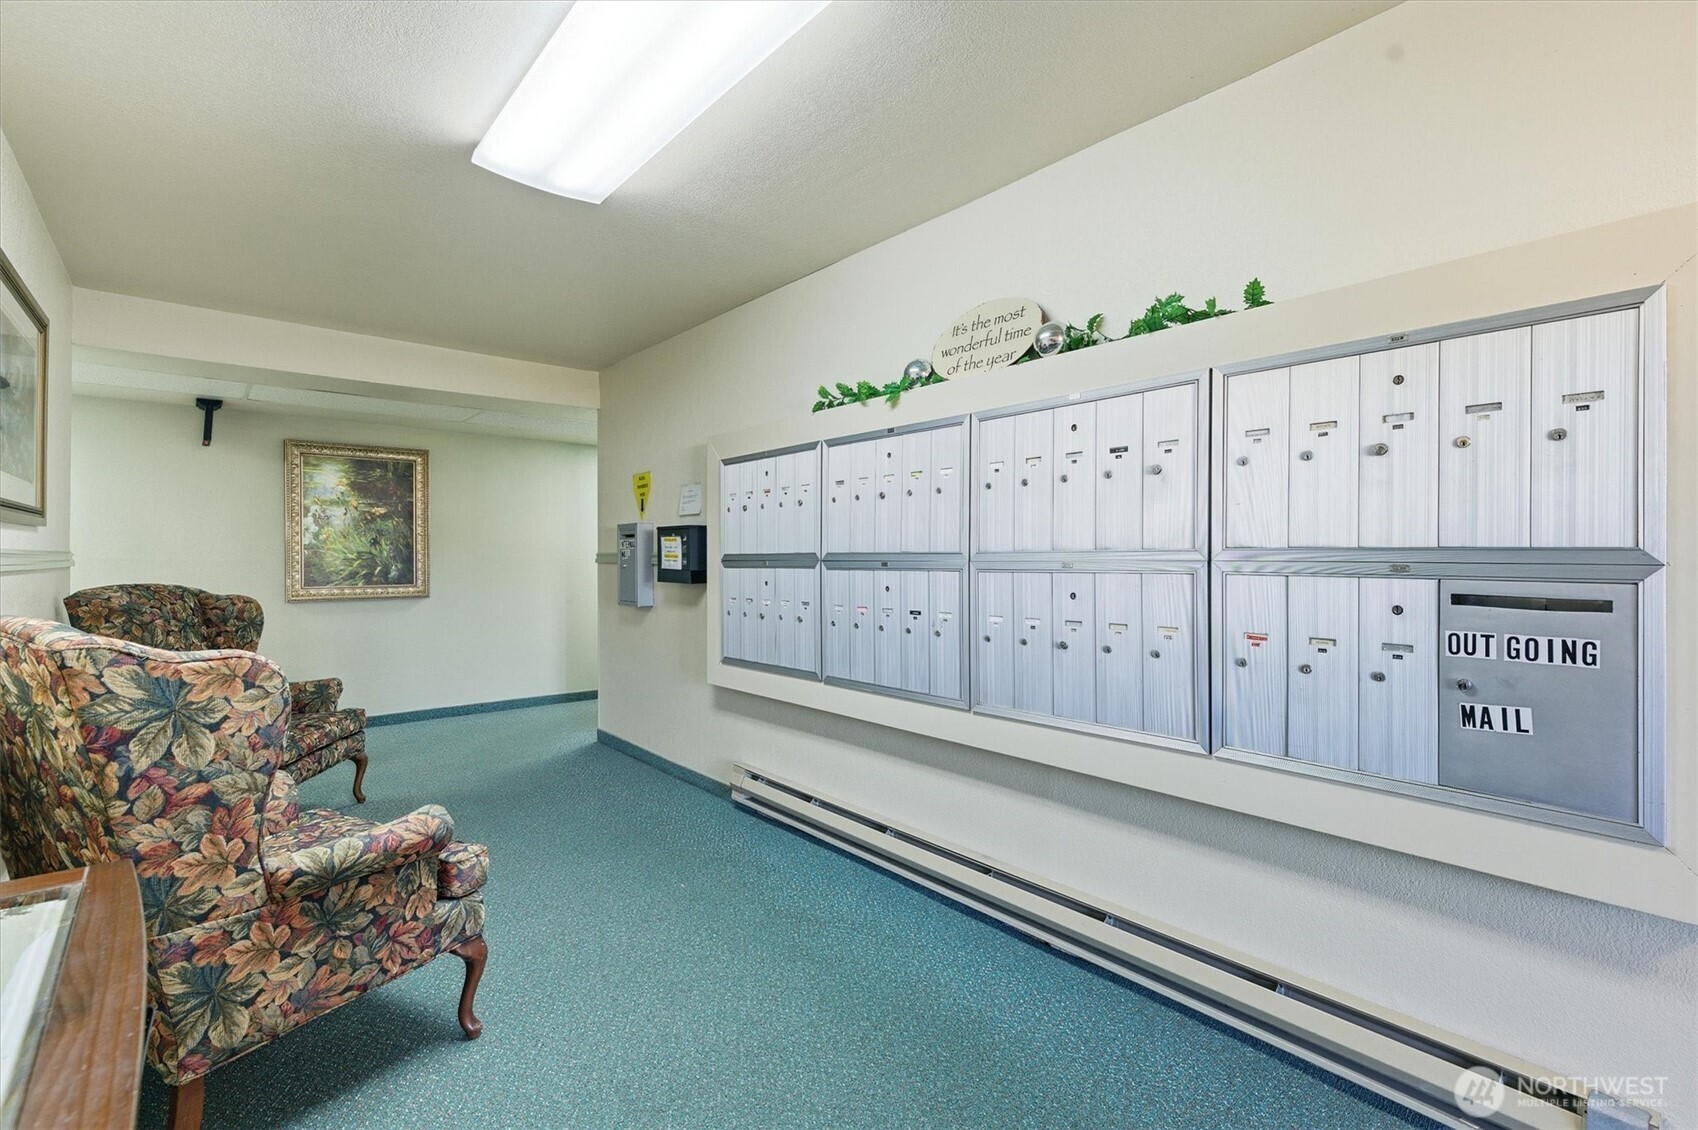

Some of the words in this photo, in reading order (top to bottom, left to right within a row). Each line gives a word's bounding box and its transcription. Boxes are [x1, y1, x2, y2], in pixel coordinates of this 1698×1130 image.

[951, 323, 968, 338] It's
[971, 314, 992, 332] the
[993, 306, 1027, 326] most
[941, 327, 1003, 358] wonderful
[1004, 326, 1032, 342] time
[946, 356, 963, 376] of
[963, 354, 984, 372] the
[986, 351, 1017, 372] year
[1447, 632, 1495, 658] OUT
[1506, 635, 1598, 667] GOING
[1460, 704, 1530, 734] MAIL
